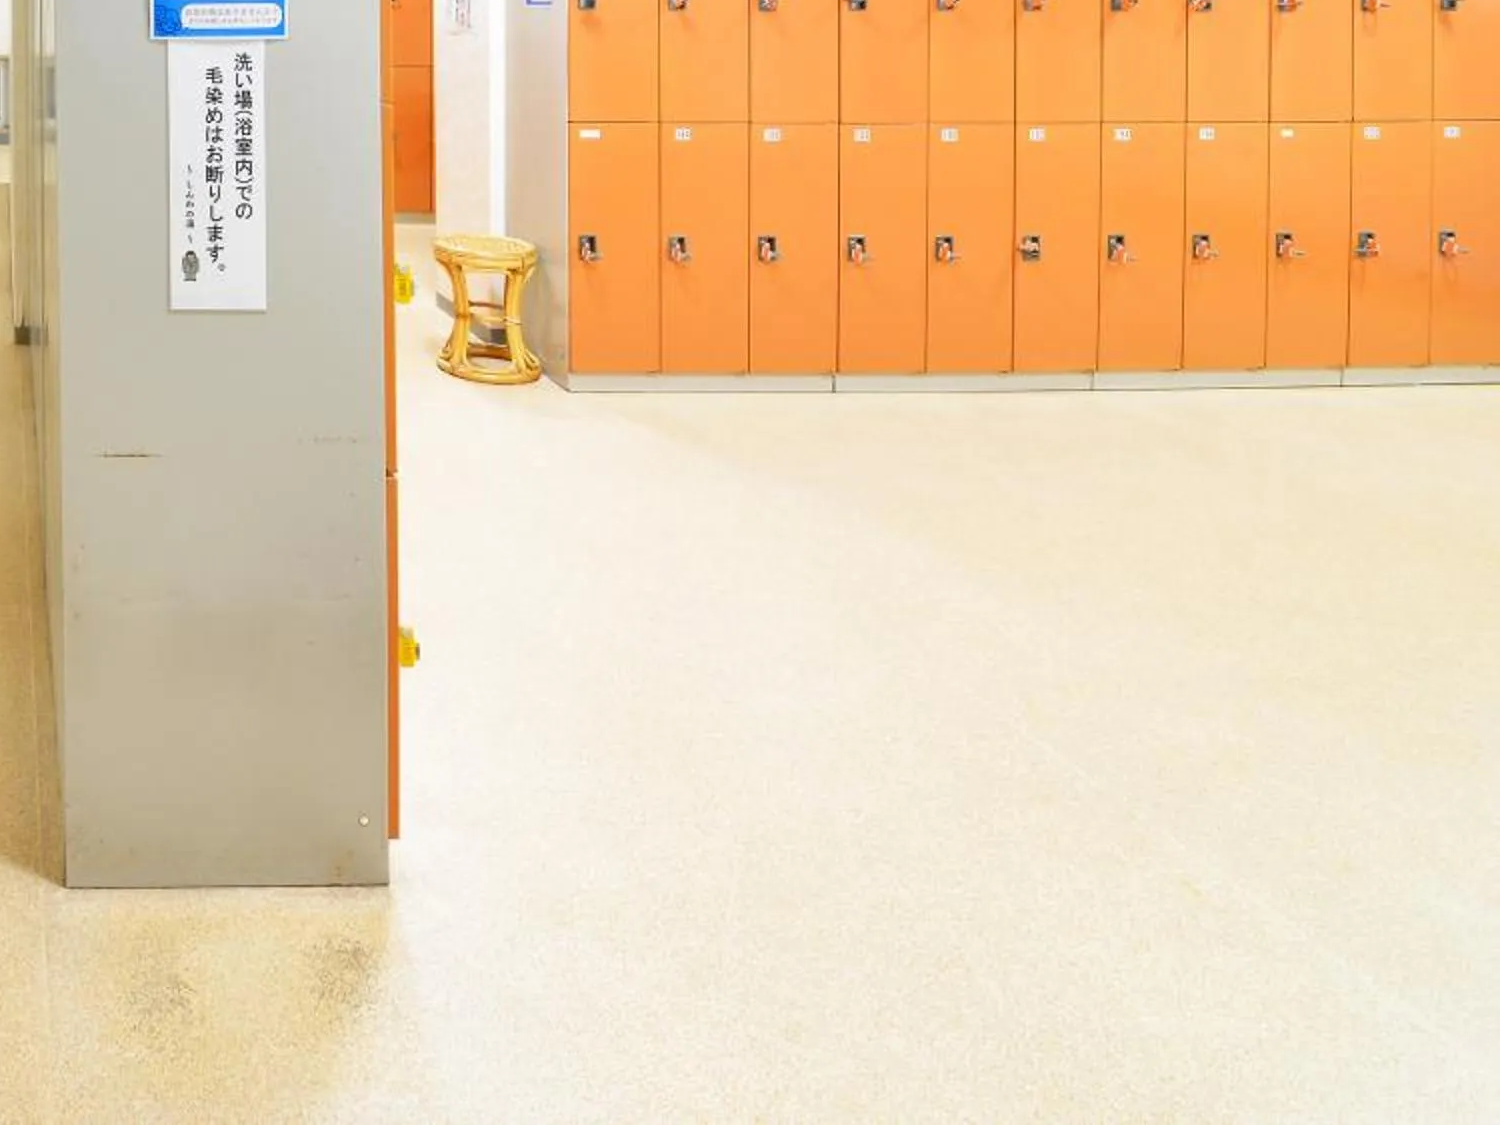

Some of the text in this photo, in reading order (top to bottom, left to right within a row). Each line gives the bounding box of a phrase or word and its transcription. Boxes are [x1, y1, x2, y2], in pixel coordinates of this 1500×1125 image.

[205, 66, 226, 272] 毛染めはお断りします。
